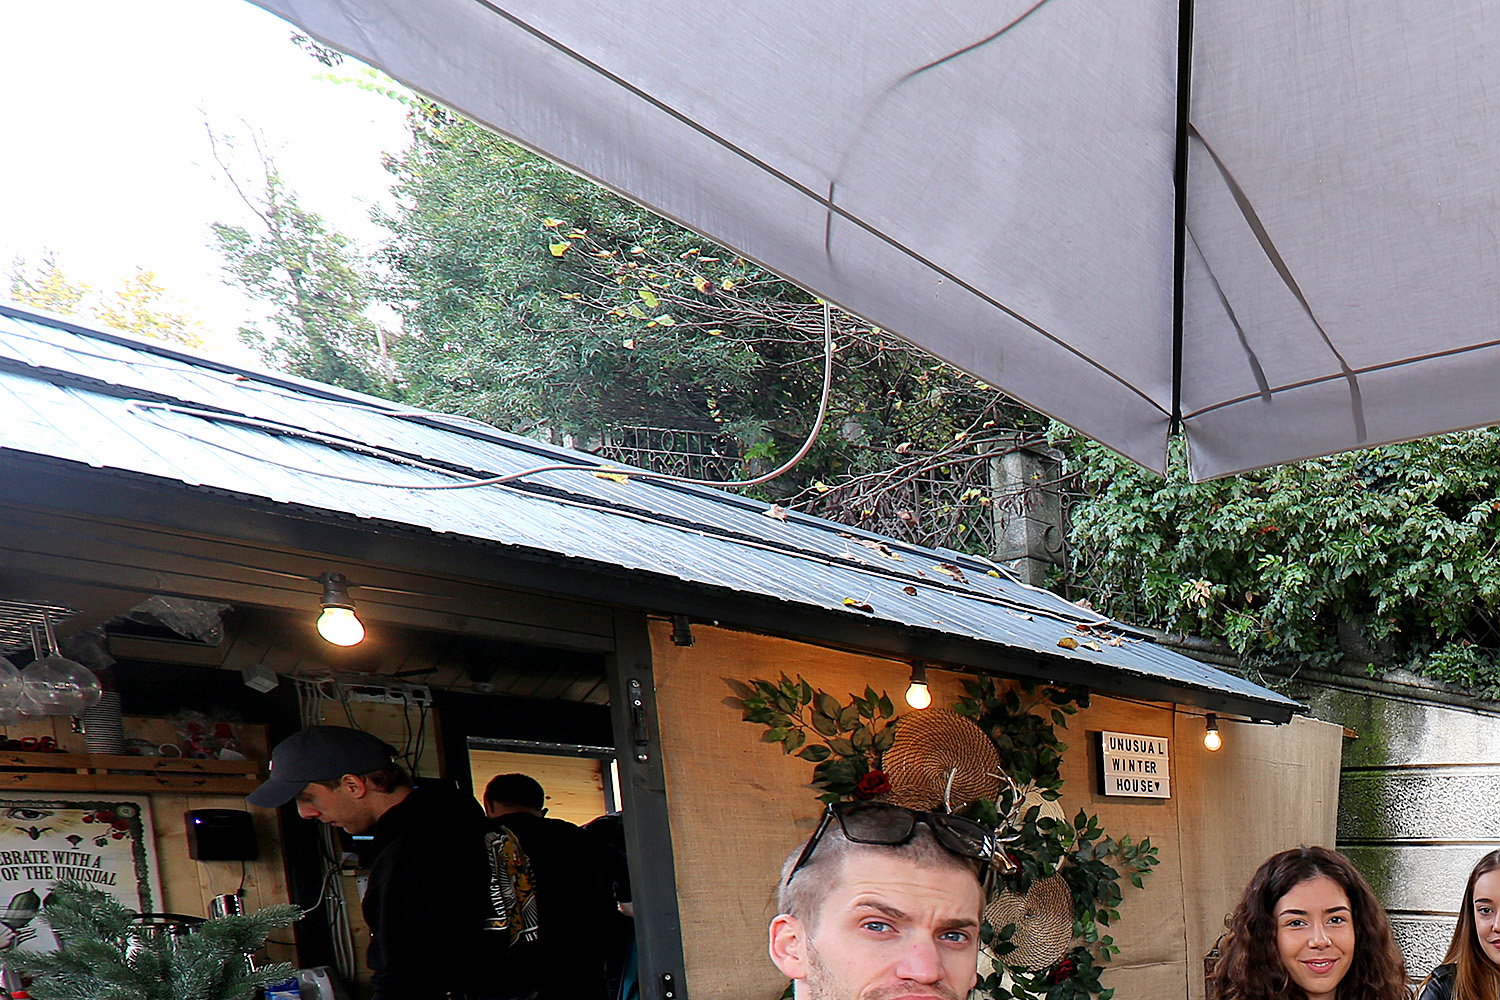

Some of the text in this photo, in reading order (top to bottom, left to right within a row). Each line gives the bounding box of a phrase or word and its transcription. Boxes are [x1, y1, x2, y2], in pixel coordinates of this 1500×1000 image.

[1110, 737, 1164, 755] UNUSUAL
[1112, 758, 1157, 774] WINTER
[1116, 778, 1153, 793] HOUSE
[52, 850, 91, 867] WITH
[92, 855, 101, 869] A
[1, 866, 117, 886] OF THE UNUSUAL
